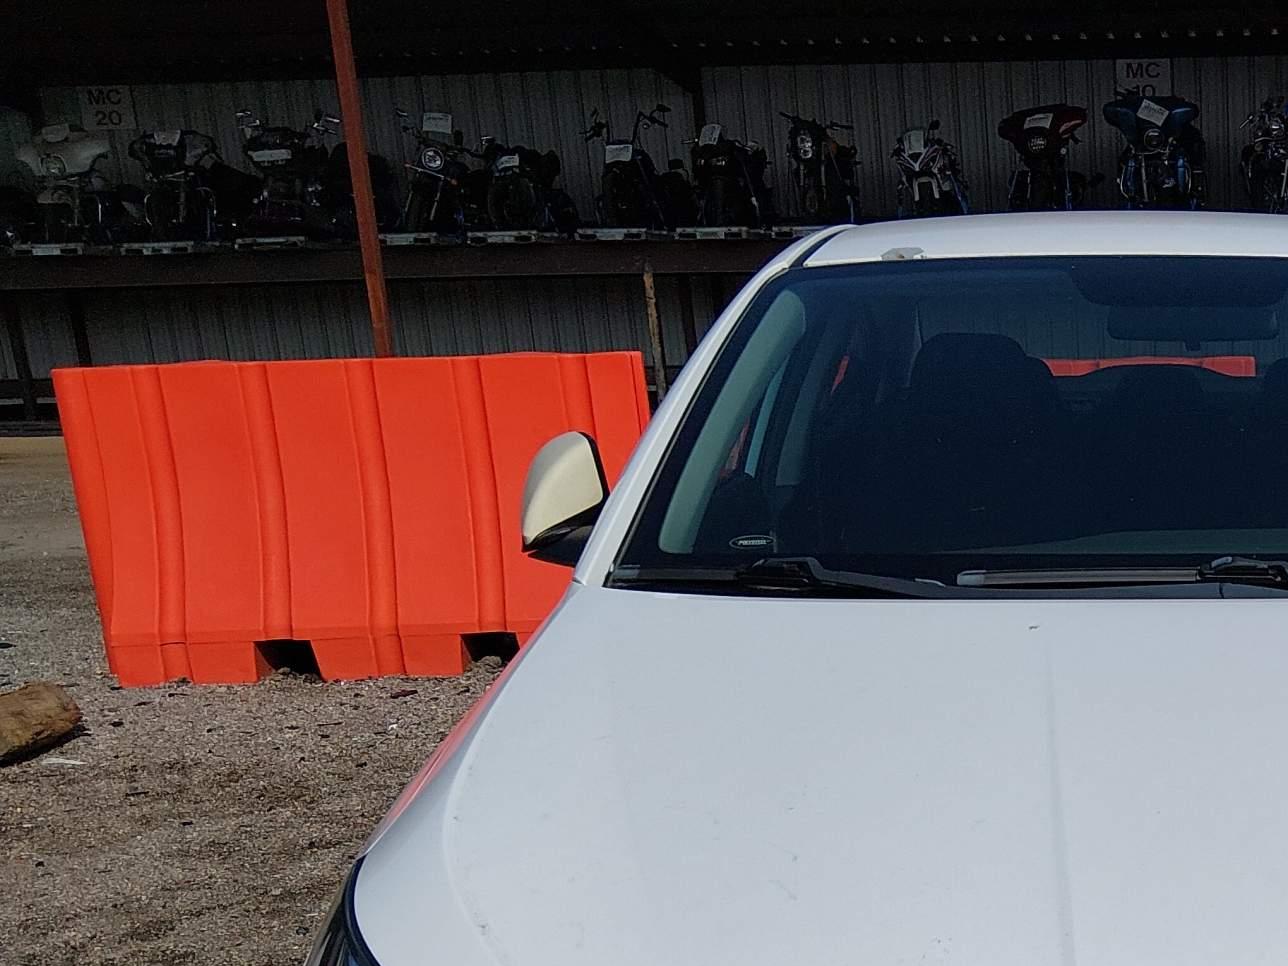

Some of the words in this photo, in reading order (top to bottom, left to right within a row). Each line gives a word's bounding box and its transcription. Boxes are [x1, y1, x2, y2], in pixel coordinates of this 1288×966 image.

[1126, 62, 1160, 78] MC
[88, 90, 121, 104] MC
[96, 110, 122, 125] 20
